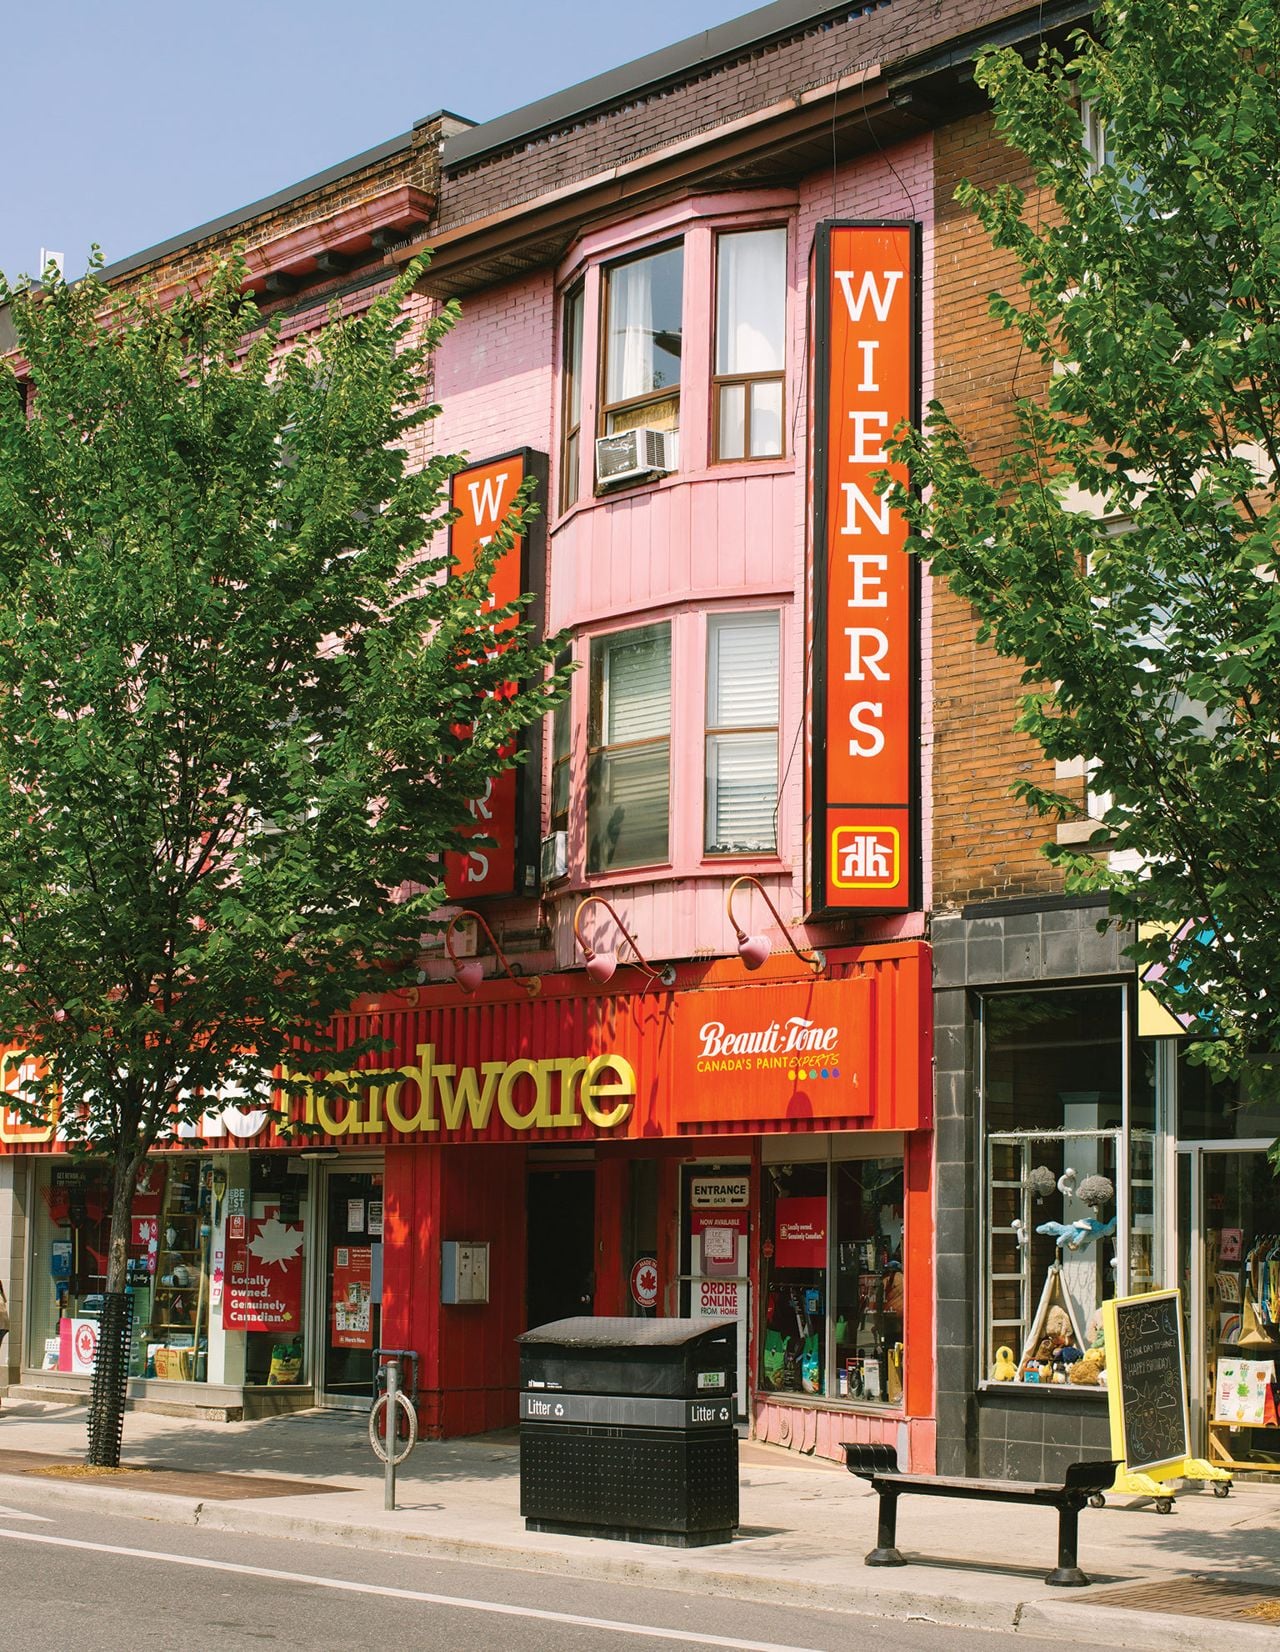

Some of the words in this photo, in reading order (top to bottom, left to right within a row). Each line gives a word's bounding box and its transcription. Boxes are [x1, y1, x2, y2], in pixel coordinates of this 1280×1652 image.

[835, 270, 904, 759] WIENERS
[696, 1057, 752, 1073] CANADA'S
[756, 1056, 789, 1069] PAINT
[788, 1053, 840, 1068] EXPERTS
[276, 1043, 637, 1137] hardware
[694, 1184, 746, 1196] ENTRANCE
[700, 1218, 713, 1226] NOW
[714, 1218, 741, 1226] AVAILABLE
[787, 1222, 800, 1232] Locally
[231, 1275, 271, 1288] Locally
[230, 1287, 271, 1297] owned.
[700, 1282, 738, 1295] ORDER
[230, 1299, 286, 1312] Genuinely
[700, 1295, 738, 1308] ONLINE
[230, 1312, 285, 1322] Canadian.
[700, 1307, 718, 1316] FROM
[719, 1307, 739, 1316] HOME
[527, 1399, 551, 1416] Litter
[691, 1406, 716, 1422] Litter
